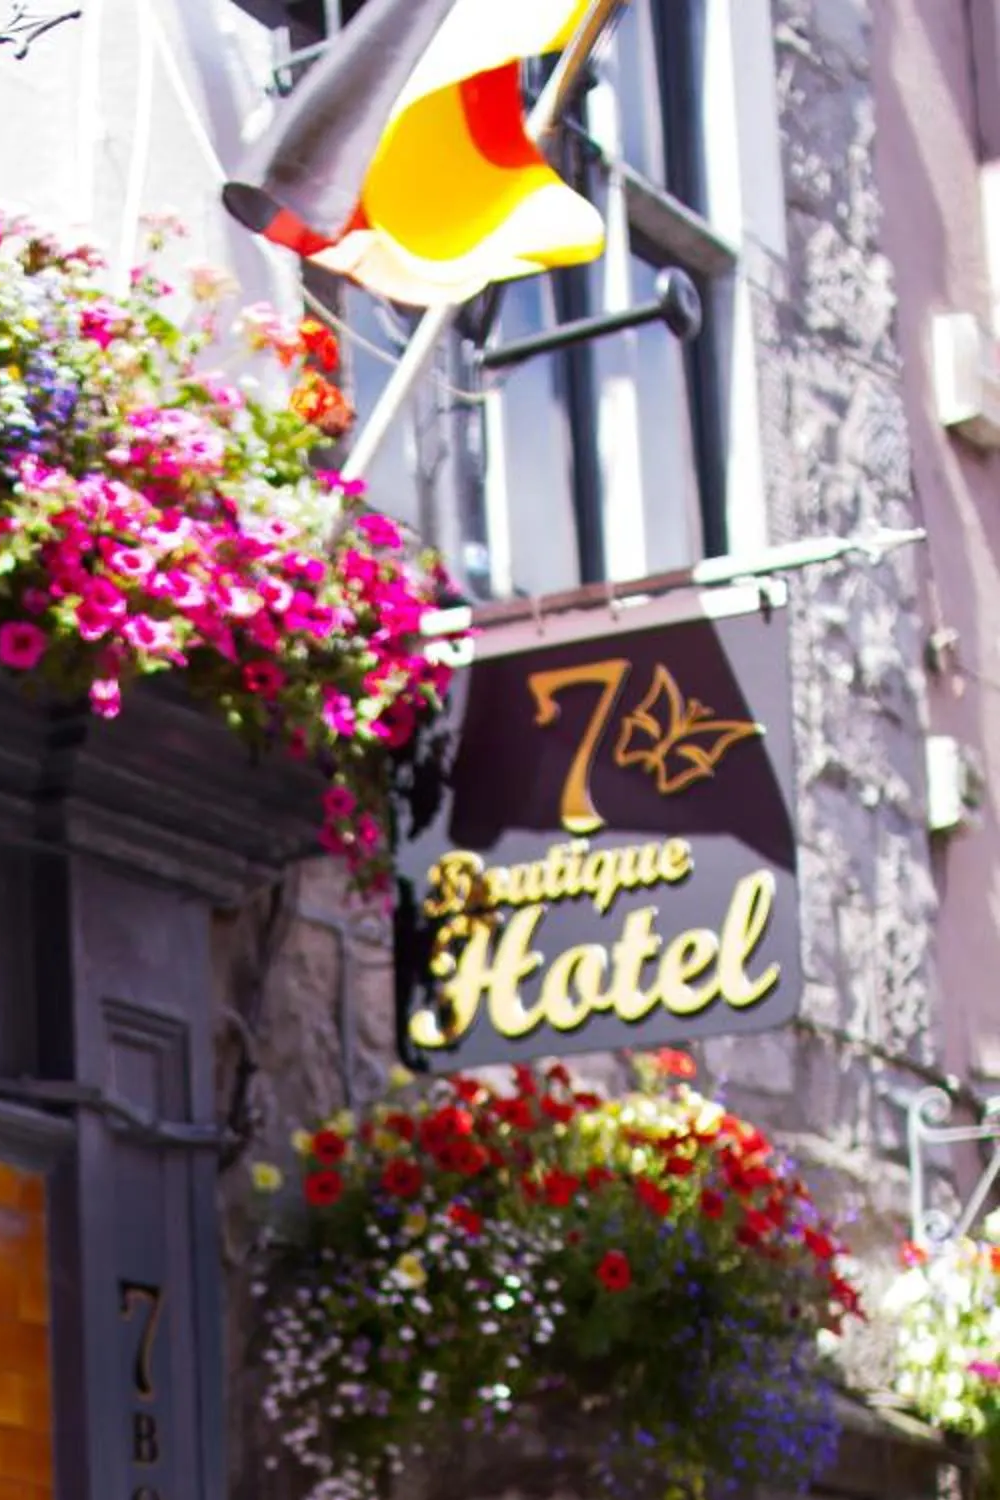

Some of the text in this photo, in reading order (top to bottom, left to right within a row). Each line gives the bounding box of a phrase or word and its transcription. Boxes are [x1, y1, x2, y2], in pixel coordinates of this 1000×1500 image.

[527, 656, 632, 836] 7
[423, 836, 696, 918] Boutique
[408, 868, 781, 1048] Hotel
[118, 1277, 162, 1401] 7
